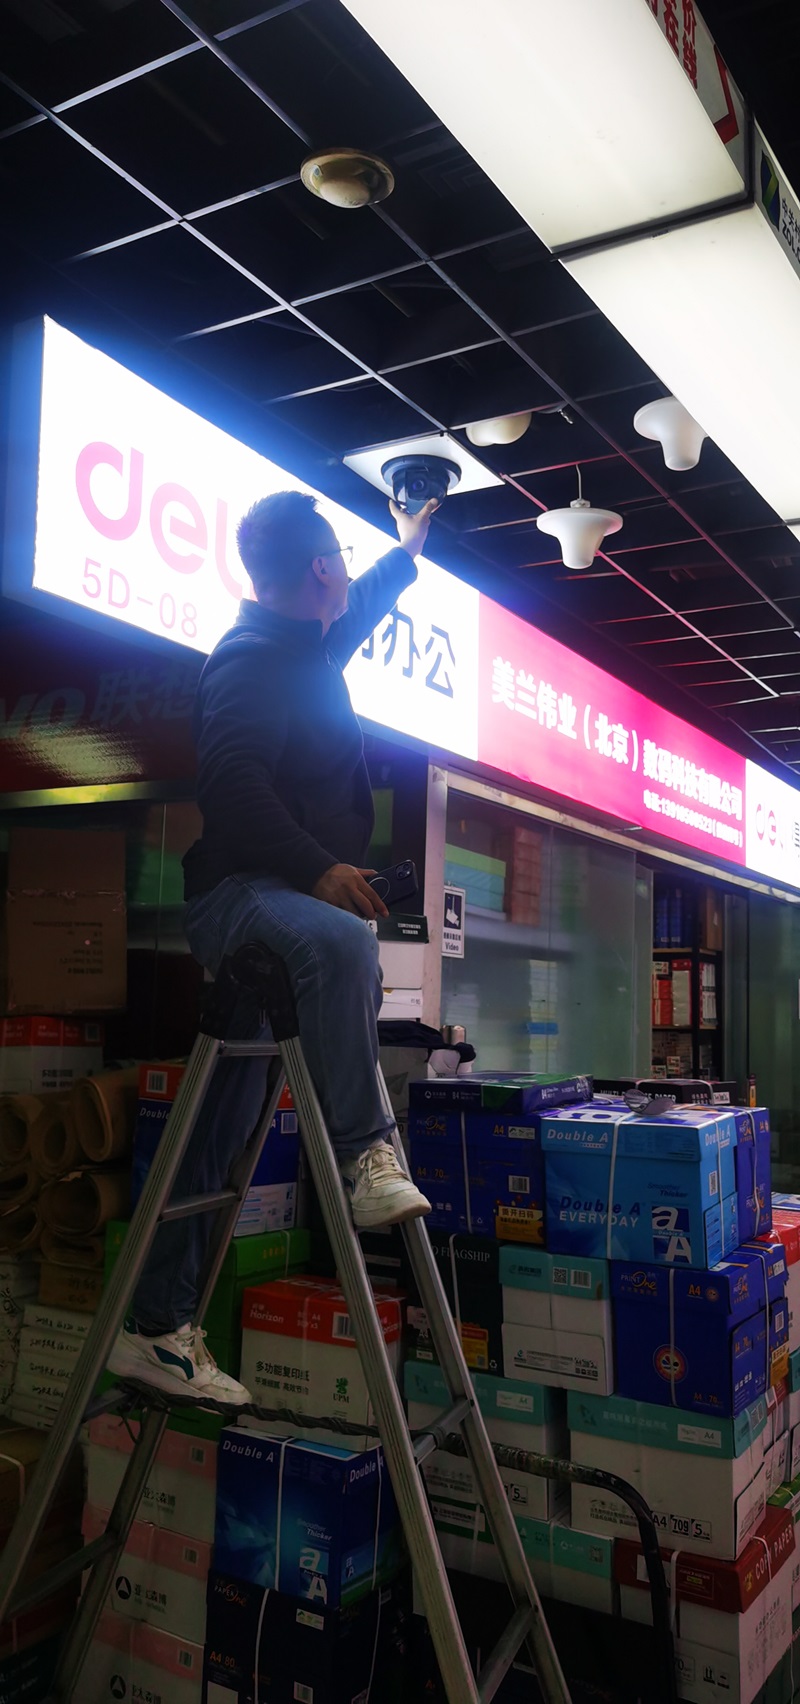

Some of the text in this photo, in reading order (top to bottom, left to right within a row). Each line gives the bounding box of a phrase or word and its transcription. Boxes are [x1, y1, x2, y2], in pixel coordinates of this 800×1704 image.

[75, 441, 257, 609] del
[82, 557, 198, 639] 5D-08
[361, 606, 456, 699] 办公
[445, 941, 459, 952] Video
[493, 1124, 505, 1135] A4
[547, 1128, 609, 1143] Double A
[660, 1190, 688, 1198] Thicker
[629, 1202, 641, 1216] A
[559, 1210, 639, 1228] EVERYDAY
[620, 1273, 641, 1284] PRINT
[688, 1284, 702, 1297] A4
[249, 1309, 284, 1324] Horizon
[311, 1314, 321, 1322] A4
[256, 1360, 310, 1382] 多功能复印纸
[333, 1392, 350, 1404] UPM
[704, 1431, 715, 1440] A4
[222, 1440, 275, 1464] Double A
[349, 1461, 377, 1484] Double
[142, 1486, 176, 1507] 亚森博
[513, 1487, 521, 1500] 5
[653, 1514, 667, 1528] A4
[694, 1523, 703, 1536] 5
[307, 1527, 333, 1541] Thicker
[774, 1523, 793, 1558] PAPER
[134, 1583, 167, 1607] 亚森博
[209, 1650, 237, 1668] A4 80
